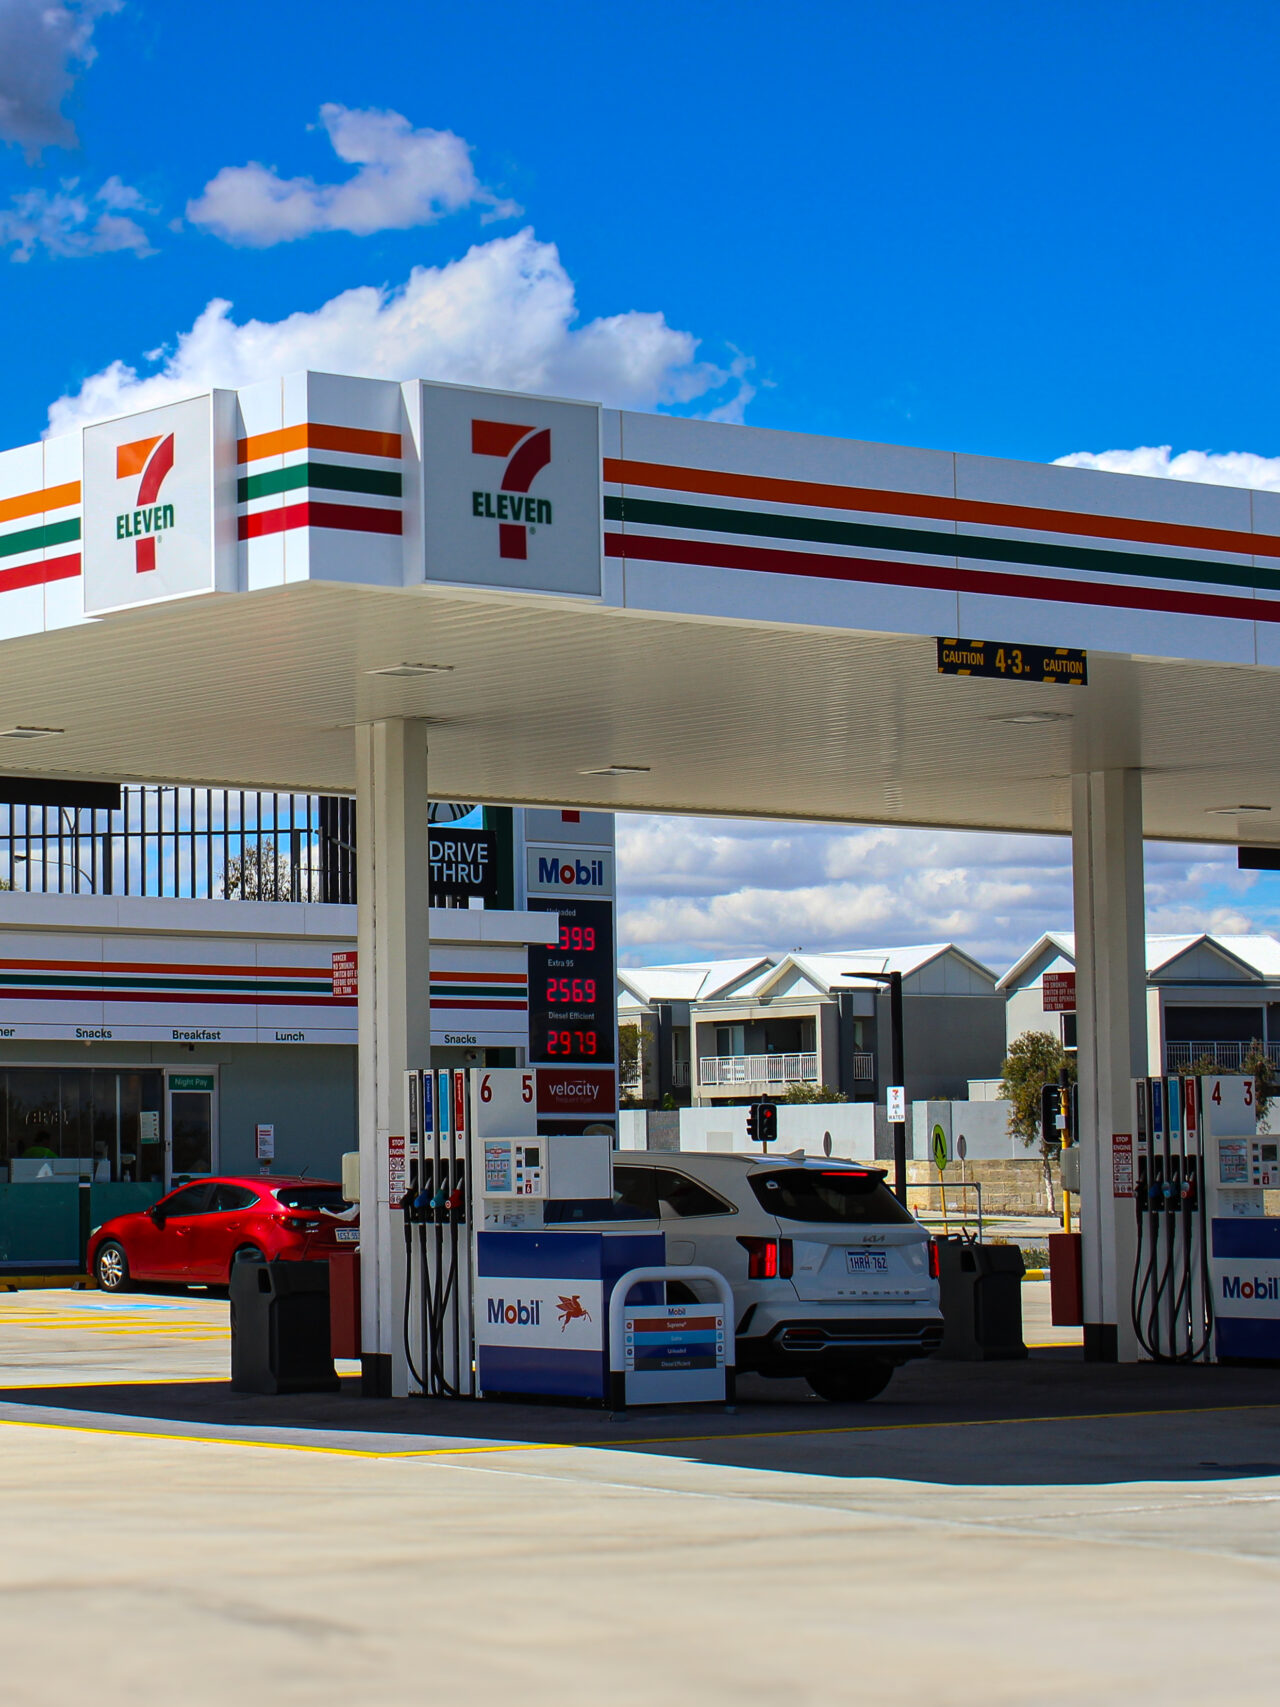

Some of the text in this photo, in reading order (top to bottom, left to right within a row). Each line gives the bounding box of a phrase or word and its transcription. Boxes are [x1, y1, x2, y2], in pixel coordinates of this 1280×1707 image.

[942, 649, 984, 666] CAUTION
[1043, 658, 1083, 674] CAUTION
[429, 840, 488, 863] DRIVE
[429, 862, 483, 884] THRU
[538, 857, 603, 886] Mobil
[547, 959, 574, 968] Extra 95
[548, 1011, 595, 1021] Diesel Efficient
[75, 1028, 112, 1039] Snacks
[172, 1030, 221, 1040] Breakfast
[275, 1031, 305, 1041] Lunch
[444, 1034, 477, 1045] Snacks
[175, 1078, 208, 1088] Night Pay
[480, 1074, 493, 1103] 6
[522, 1074, 533, 1103] 5
[548, 1080, 600, 1100] velocity
[1211, 1081, 1253, 1106] 4 3
[1222, 1275, 1279, 1300] Mobil
[487, 1298, 540, 1326] Mobil
[668, 1307, 686, 1316] Mobil
